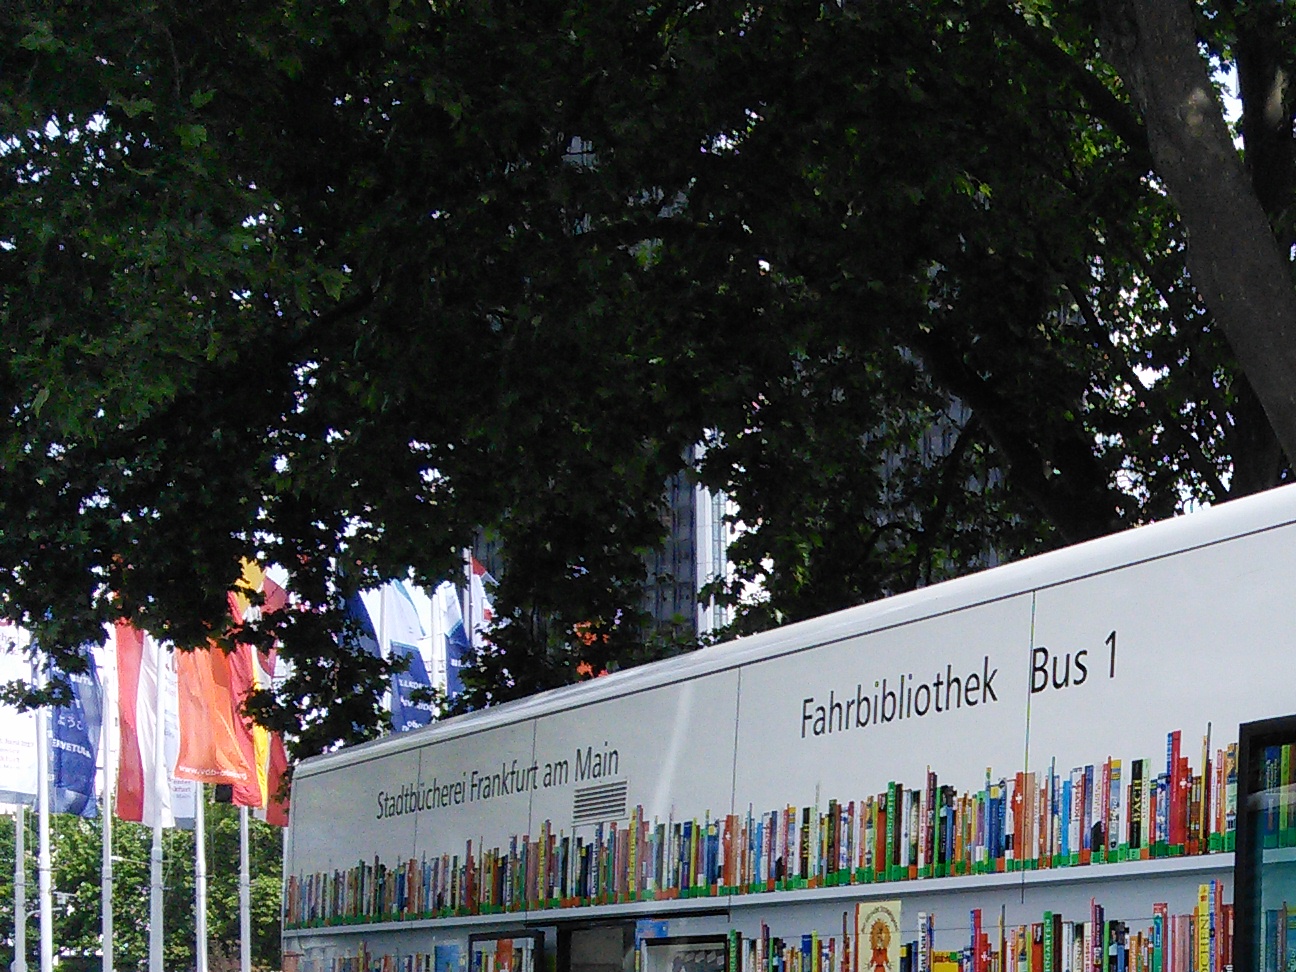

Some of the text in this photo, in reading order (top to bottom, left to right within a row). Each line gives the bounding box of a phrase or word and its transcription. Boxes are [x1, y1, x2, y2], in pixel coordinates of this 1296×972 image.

[801, 630, 1117, 738] Fahrbibliothek Bus 1
[376, 740, 619, 820] Stadtbücherei Frankfurt am Main
[1131, 779, 1141, 822] BACH
